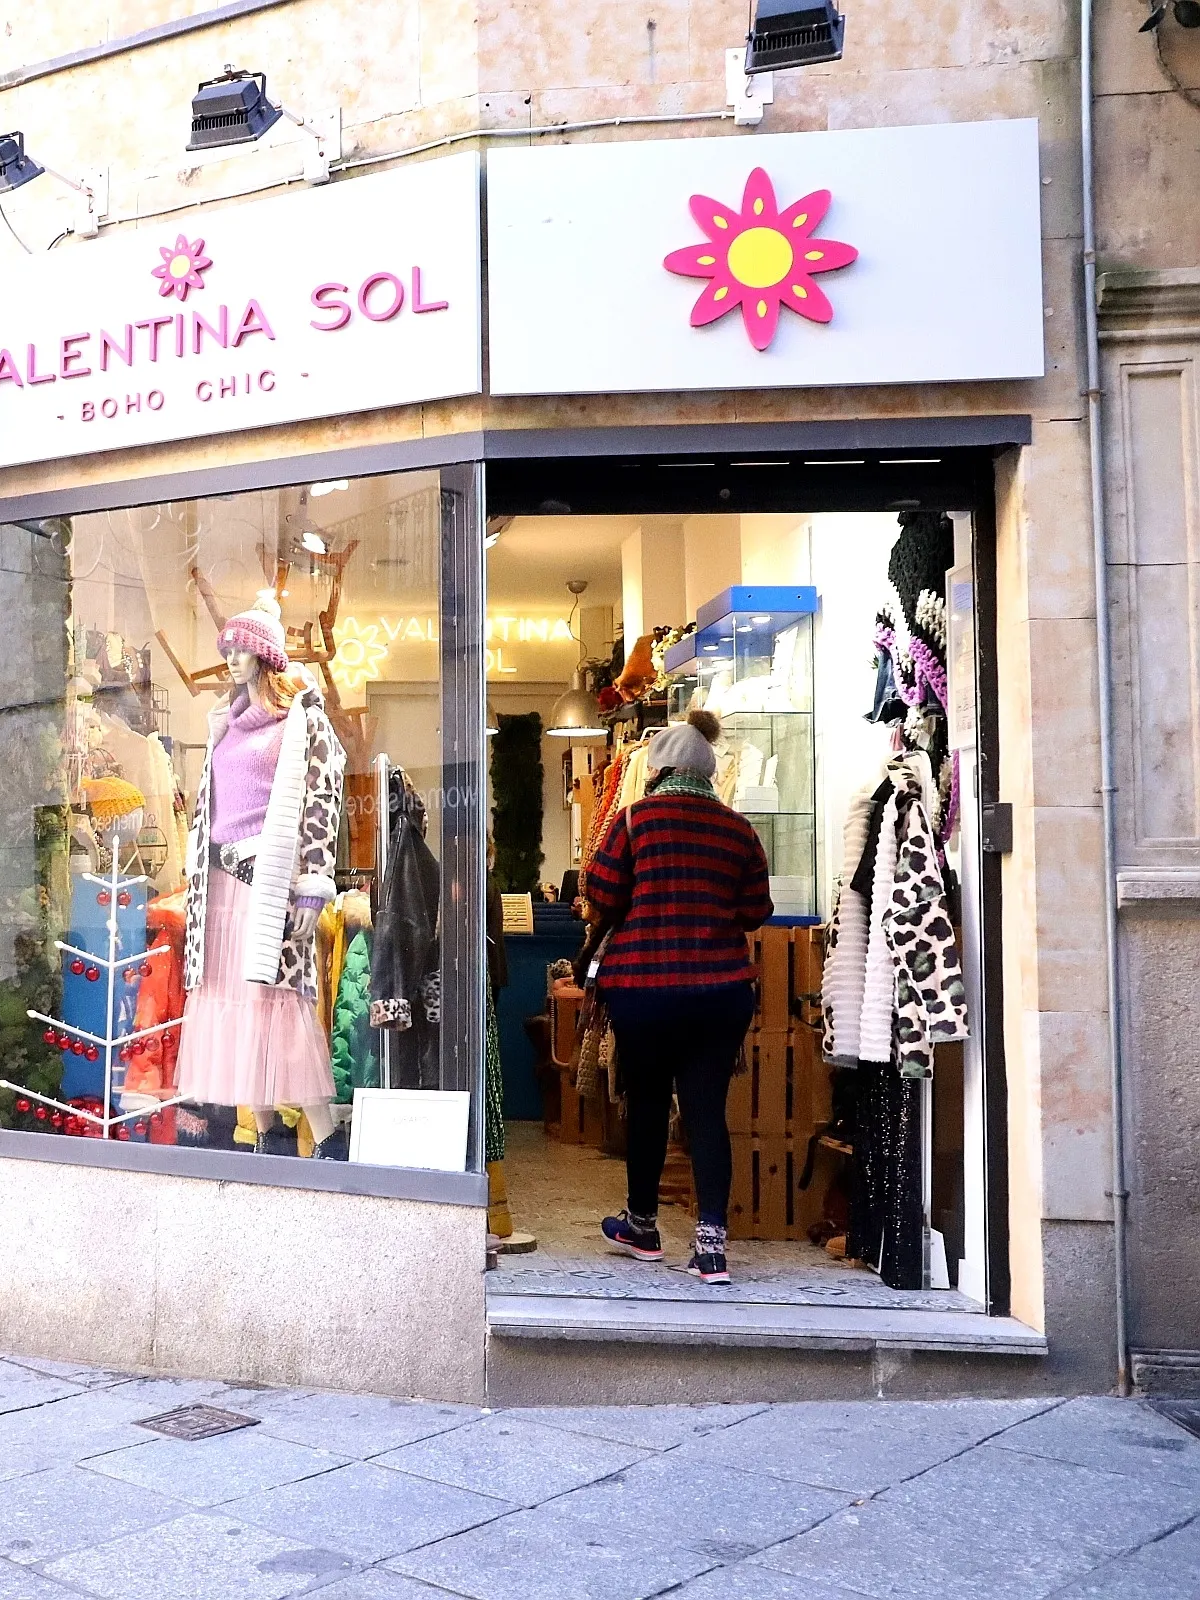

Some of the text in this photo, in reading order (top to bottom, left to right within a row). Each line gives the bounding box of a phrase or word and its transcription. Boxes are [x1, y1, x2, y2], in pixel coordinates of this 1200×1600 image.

[309, 265, 449, 331] SOL
[80, 389, 164, 422] BOHO
[196, 369, 276, 402] CHIC
[380, 616, 574, 641] VALTINA
